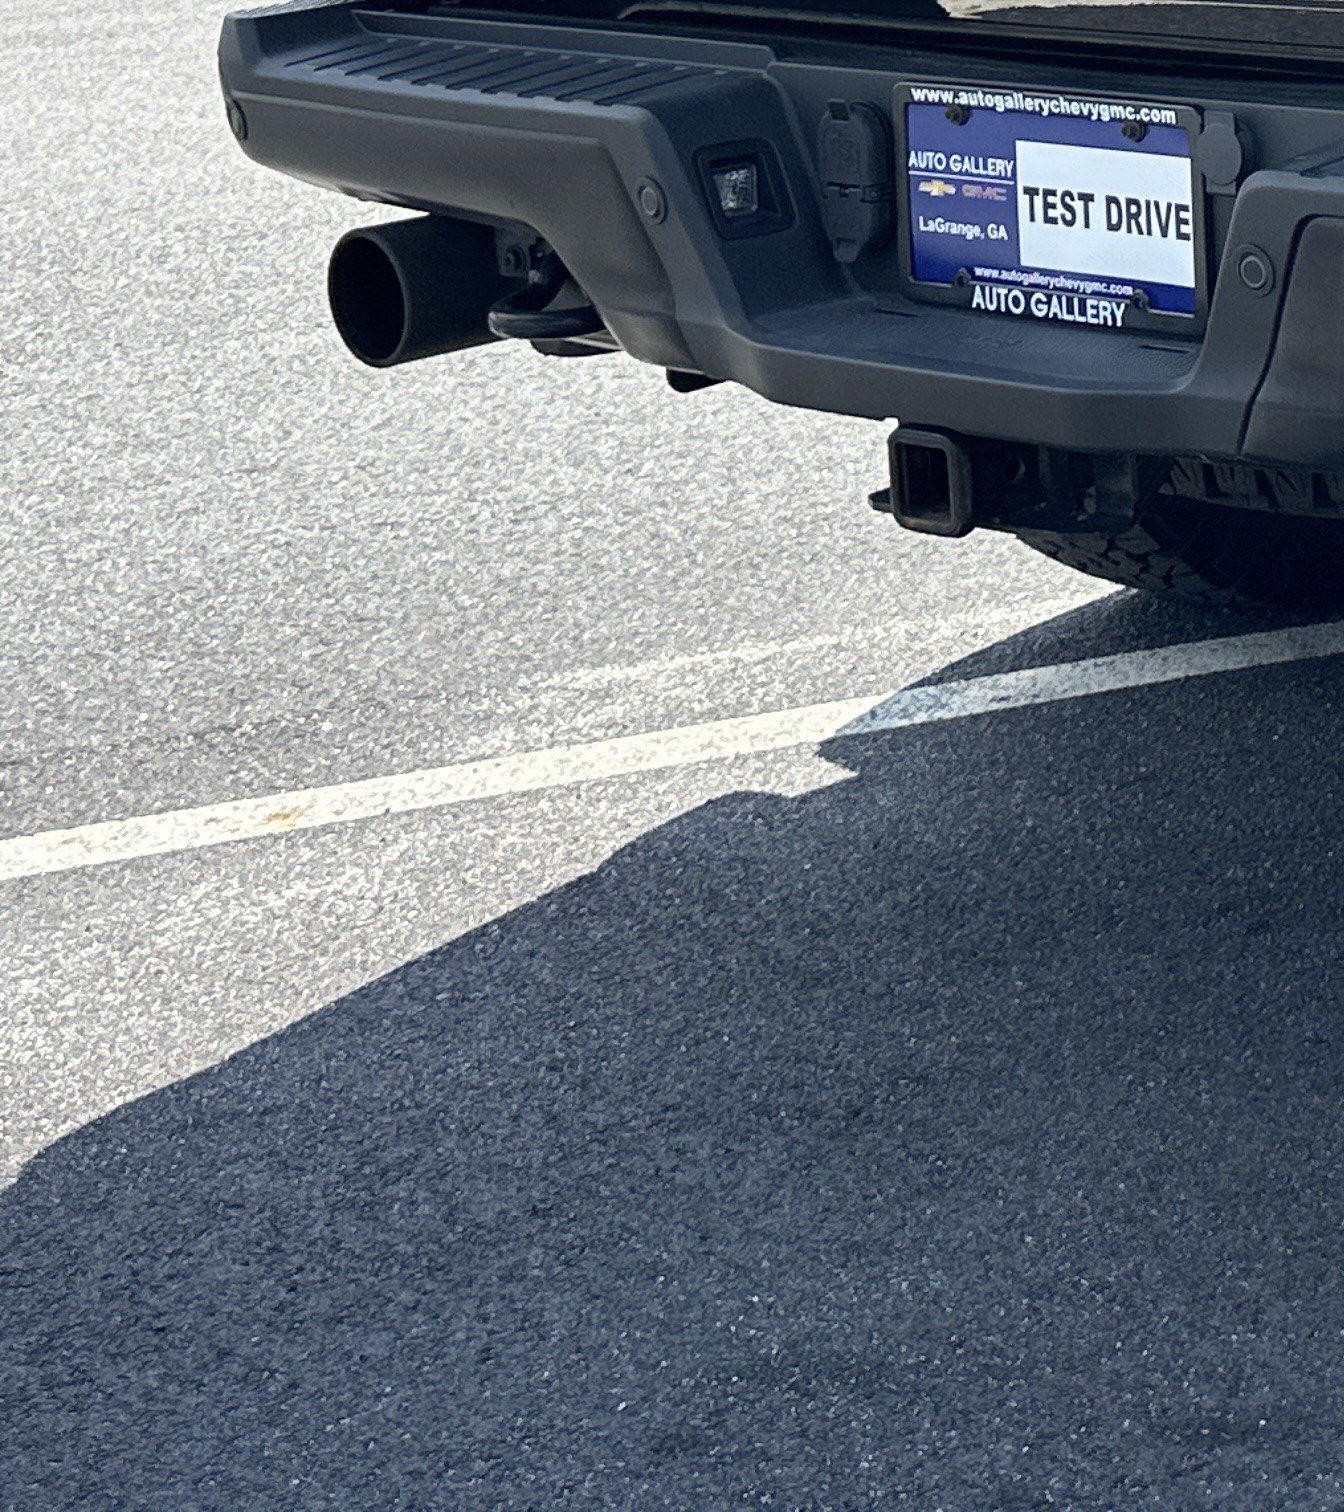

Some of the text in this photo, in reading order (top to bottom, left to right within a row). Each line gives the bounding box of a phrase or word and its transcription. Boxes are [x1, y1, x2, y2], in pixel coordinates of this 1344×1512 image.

[910, 86, 1176, 125] www.autogallerychevygmc.com
[908, 150, 1014, 178] AUTO GALLERY
[918, 215, 1009, 241] LaGrange, GA
[1023, 185, 1192, 241] TEST DRIVE
[972, 284, 1126, 327] AUTO GALLERY
